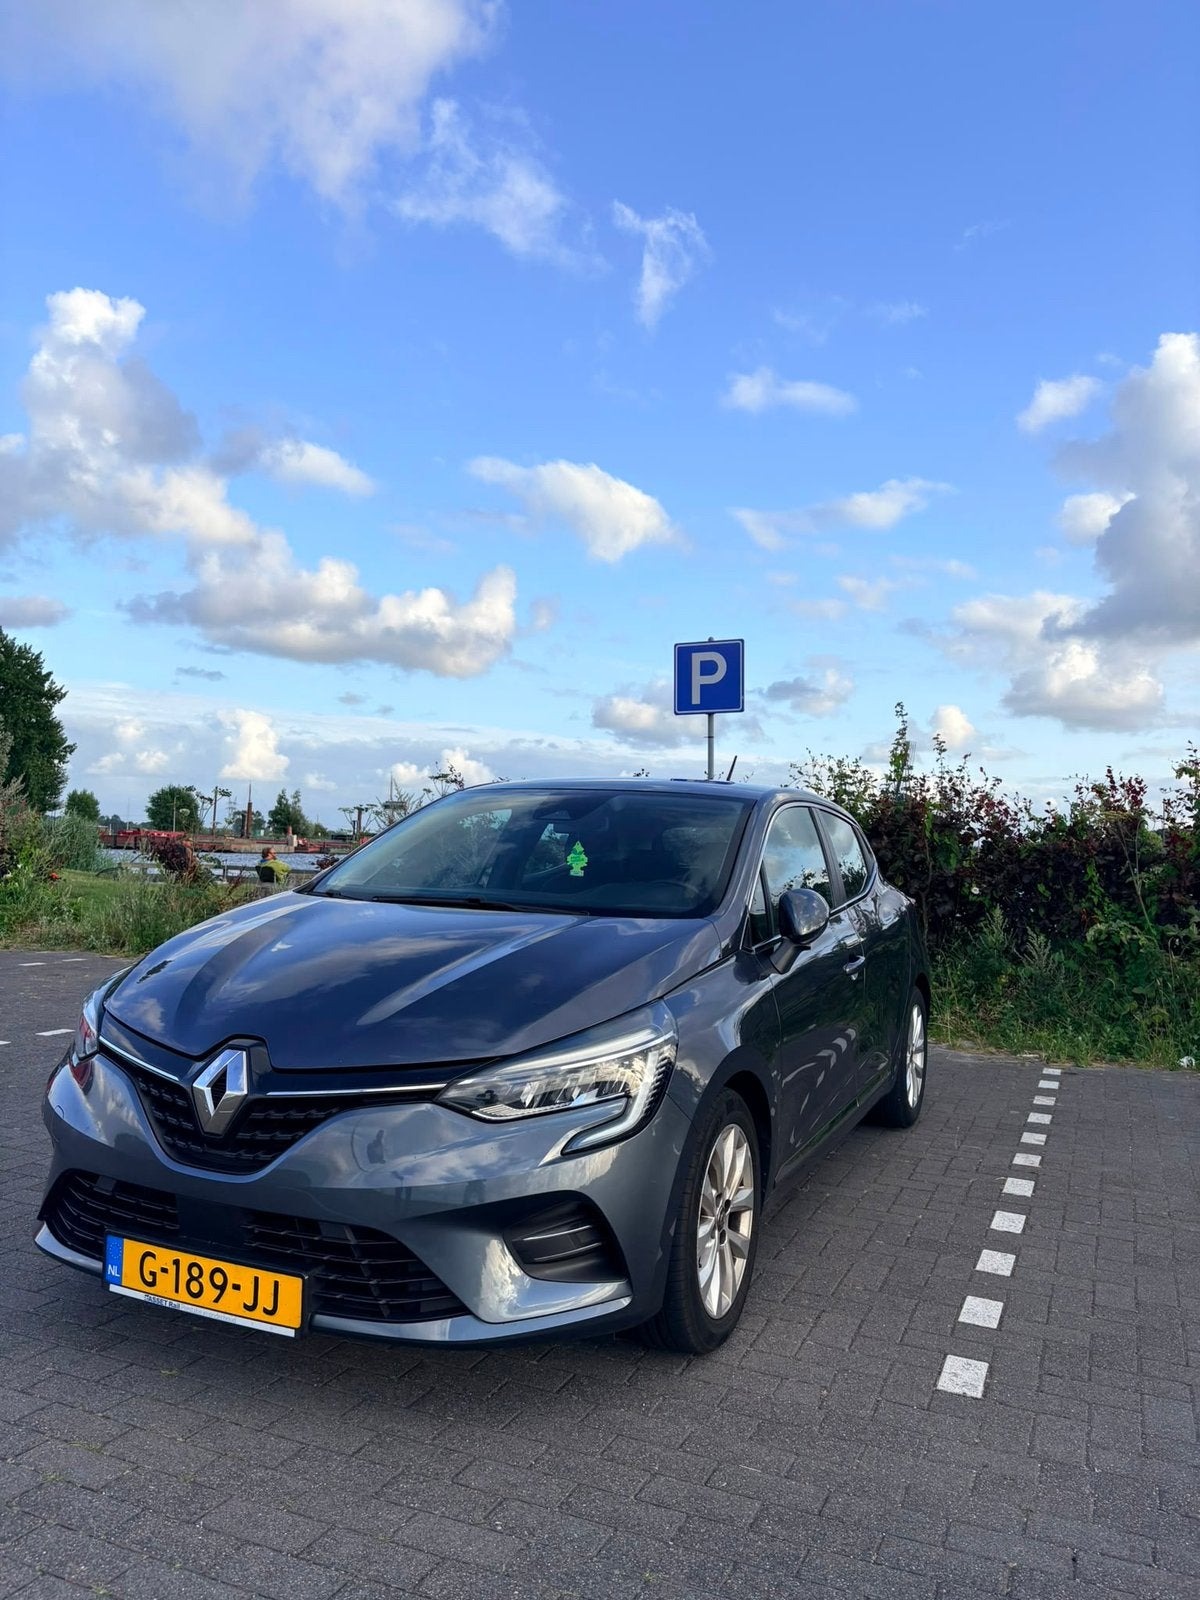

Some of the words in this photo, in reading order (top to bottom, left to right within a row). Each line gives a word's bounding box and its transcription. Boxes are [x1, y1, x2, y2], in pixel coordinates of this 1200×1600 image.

[692, 651, 727, 704] P
[107, 1264, 120, 1277] NL
[139, 1250, 280, 1316] G-189-JJ
